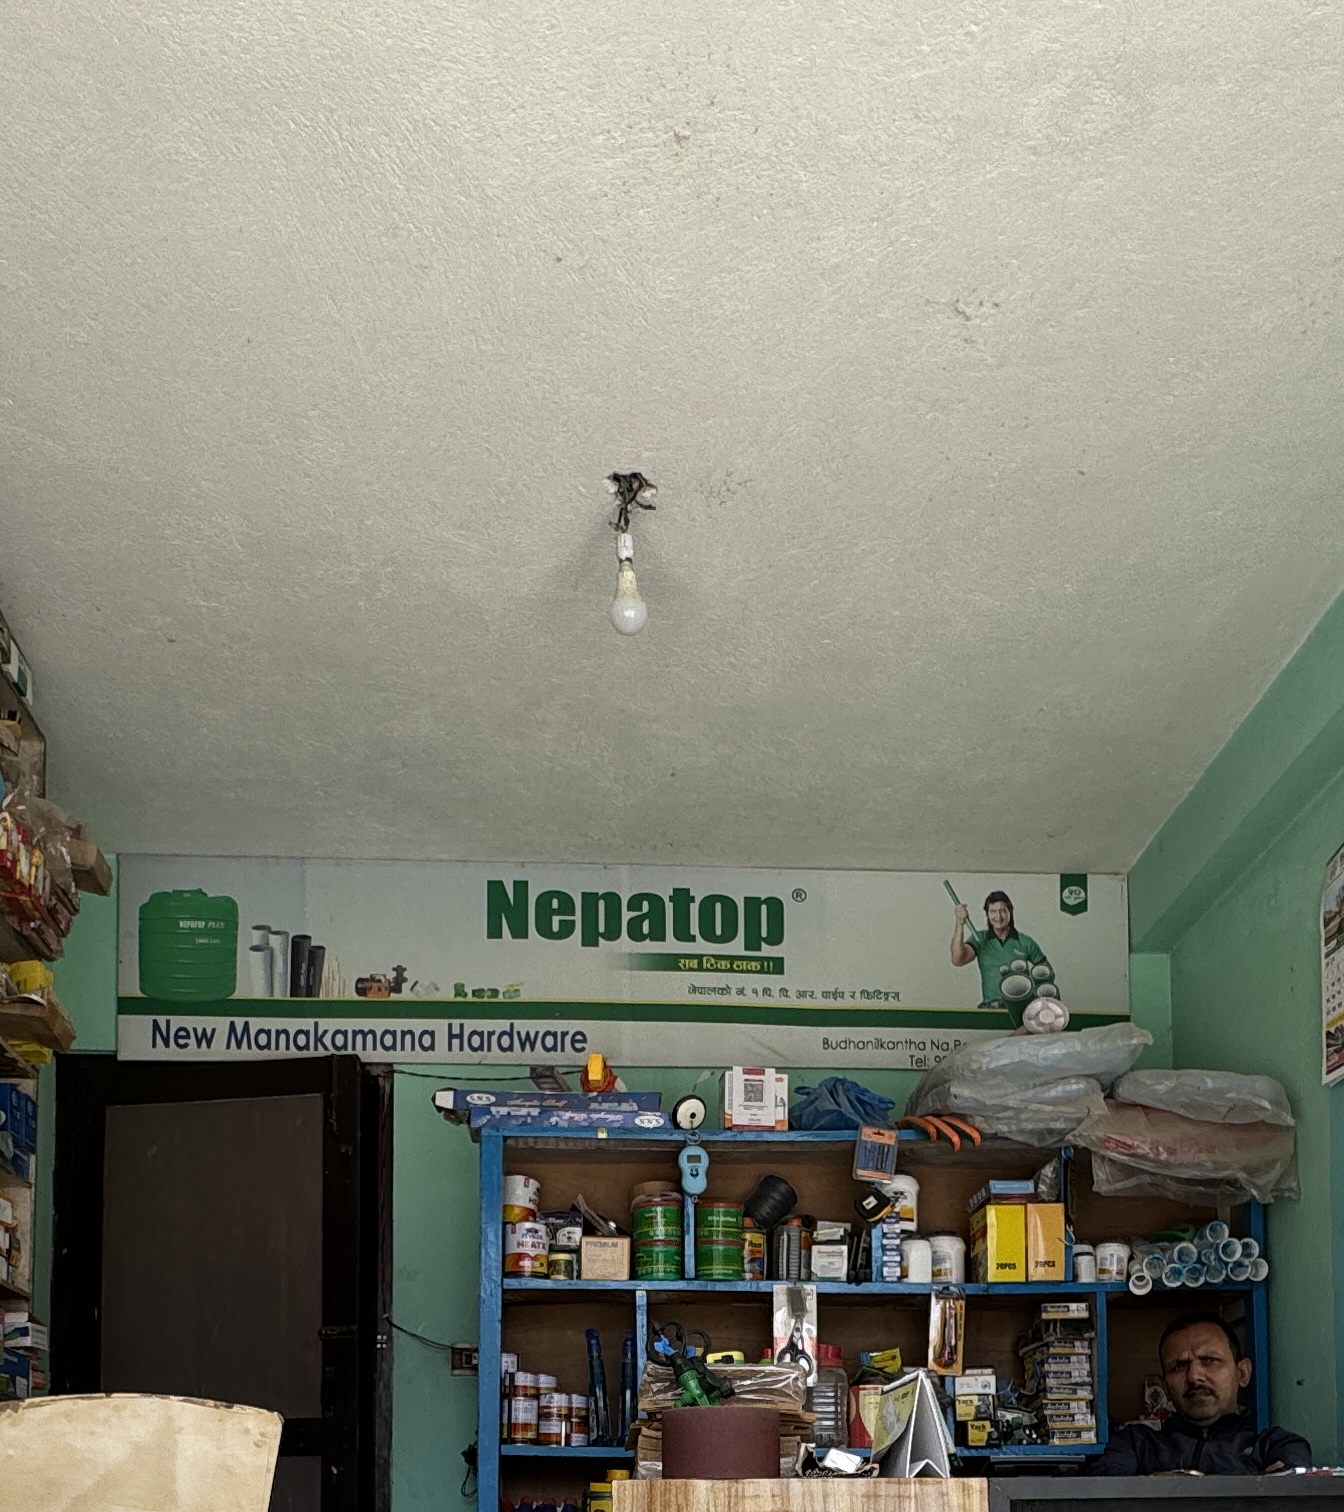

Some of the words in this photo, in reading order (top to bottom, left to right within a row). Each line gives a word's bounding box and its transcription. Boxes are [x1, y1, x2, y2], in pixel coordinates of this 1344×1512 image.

[486, 879, 785, 952] Nepatop
[151, 1018, 215, 1050] New
[226, 1020, 437, 1053] Manakamana
[447, 1023, 589, 1054] Hardware
[822, 1036, 927, 1052] Budhanilkantha
